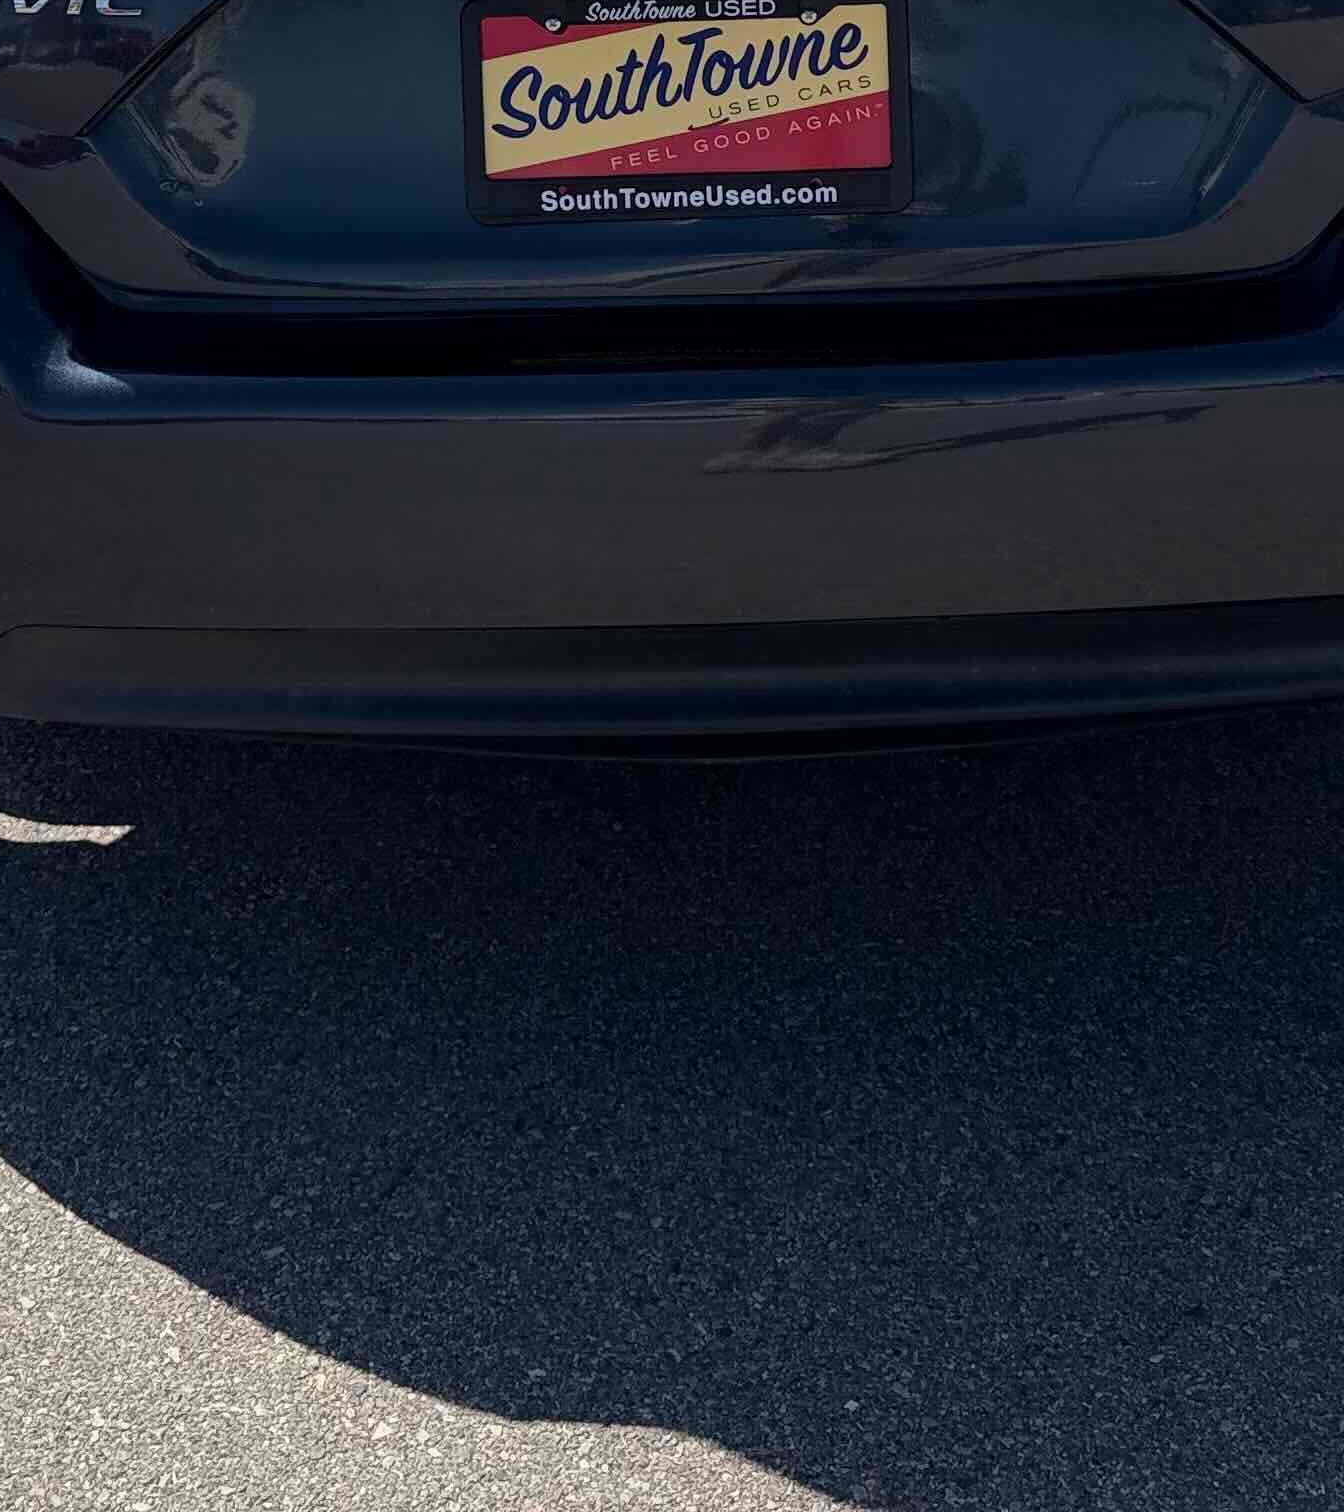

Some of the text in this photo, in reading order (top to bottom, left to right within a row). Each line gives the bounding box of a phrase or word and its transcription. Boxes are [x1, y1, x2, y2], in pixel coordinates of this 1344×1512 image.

[585, 0, 776, 21] SouthTowne USED
[491, 23, 868, 138] SouthTowne
[709, 75, 872, 119] USED CARS
[610, 146, 678, 170] FEEL
[694, 126, 770, 153] GOOD
[541, 185, 837, 211] SouthTowneUsed.com
